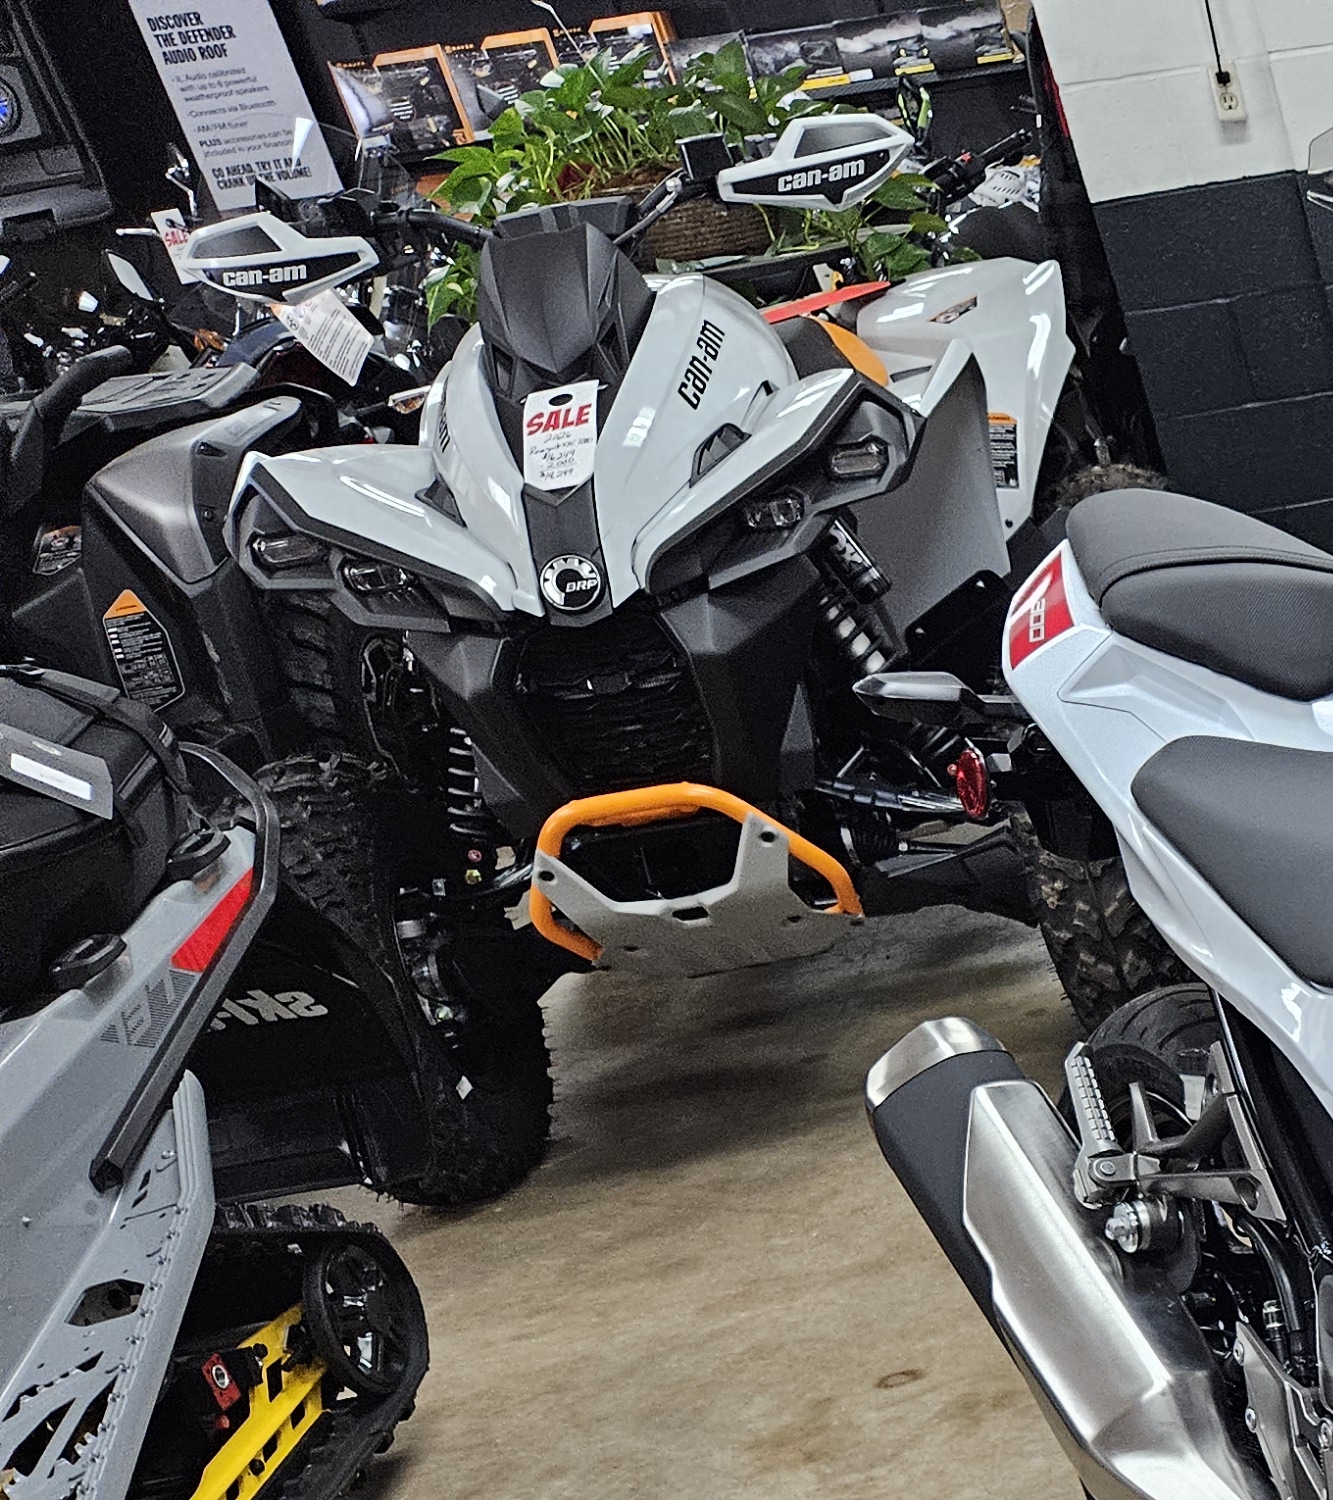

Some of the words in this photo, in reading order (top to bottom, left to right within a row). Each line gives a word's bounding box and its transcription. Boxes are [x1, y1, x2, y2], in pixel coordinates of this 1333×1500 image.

[147, 12, 204, 32] DISCOVER
[153, 32, 178, 48] THE
[178, 25, 236, 45] DEFENDER
[162, 48, 197, 65] AUDIO
[198, 43, 228, 60] ROOF
[199, 138, 223, 148] PLUS
[212, 167, 225, 179] GO
[255, 160, 272, 172] TRY
[273, 158, 283, 169] IT
[778, 159, 865, 192] can-am
[217, 177, 247, 190] CRANK
[223, 264, 307, 287] can-am
[677, 320, 725, 410] can-am
[527, 403, 592, 436] SALE
[565, 577, 598, 594] BRP
